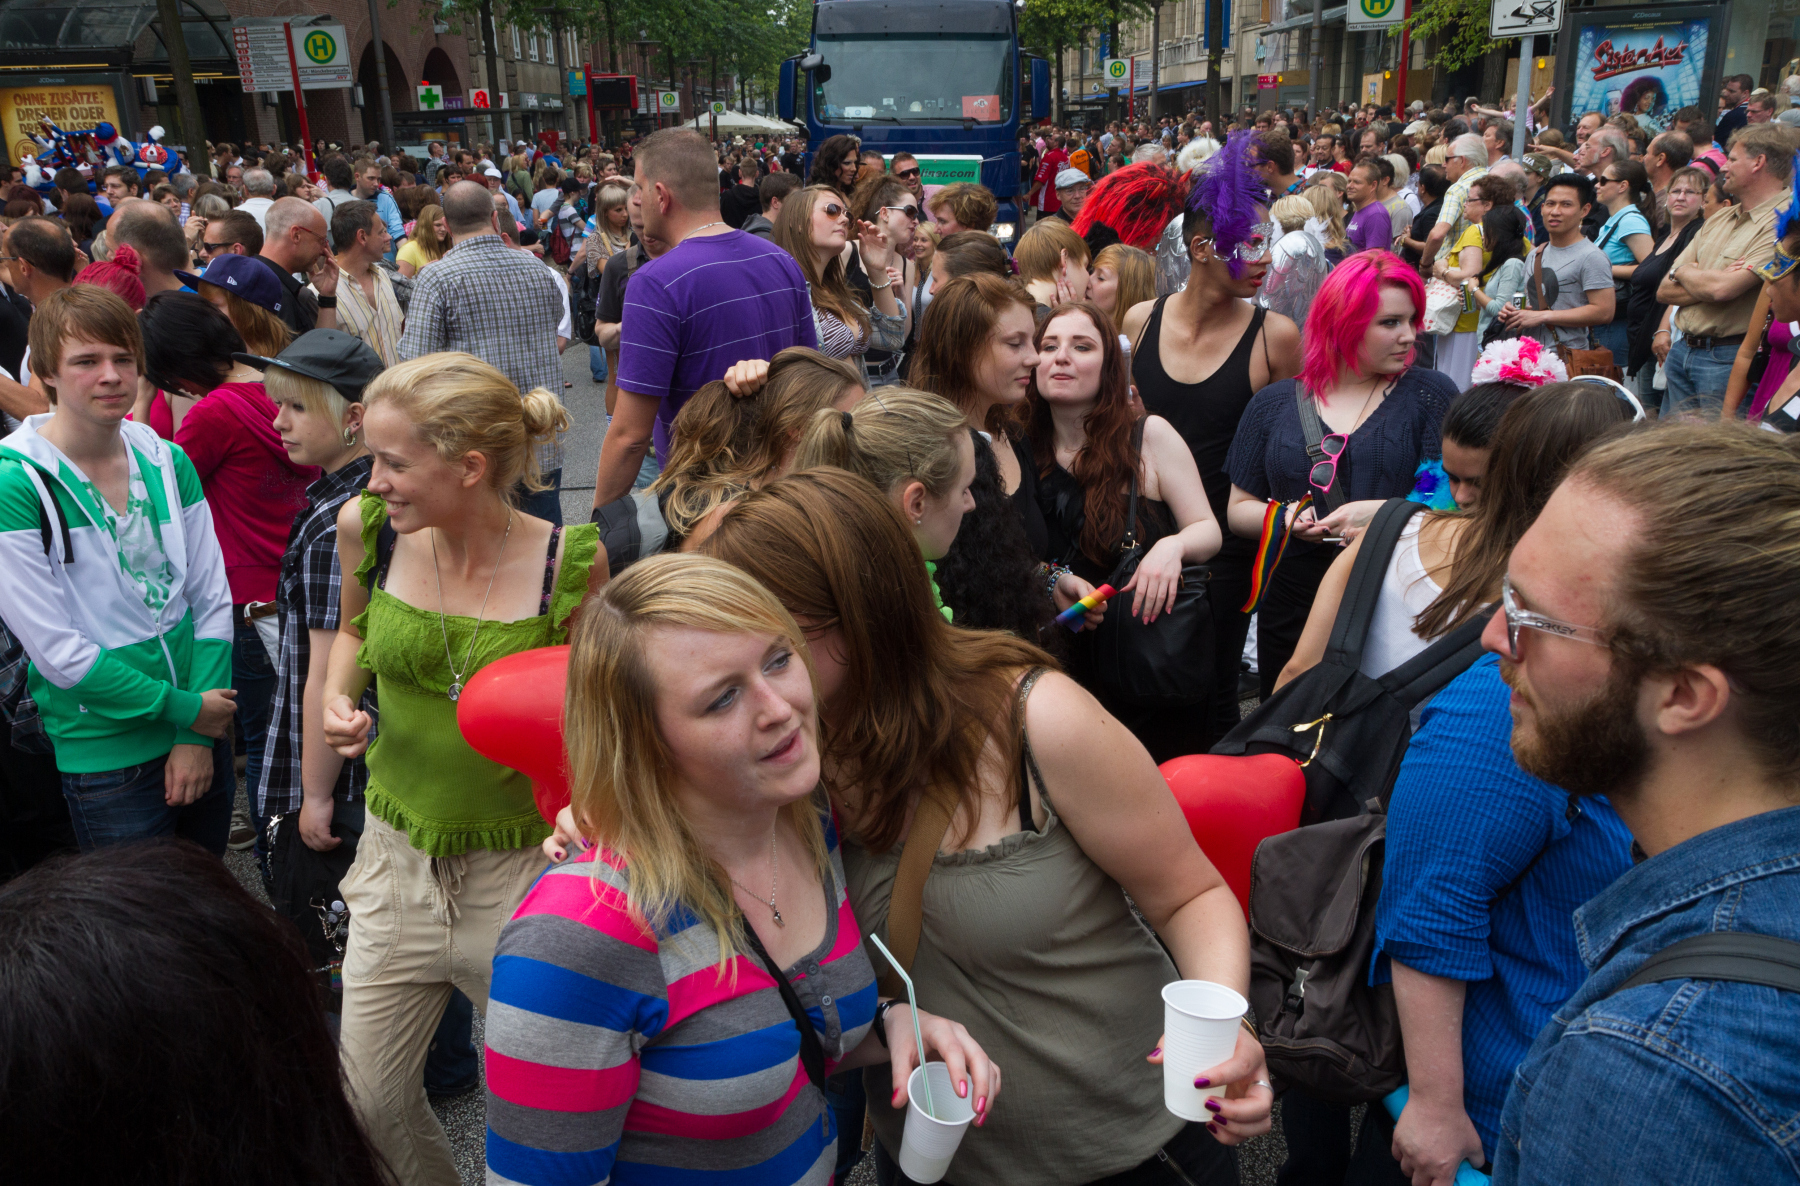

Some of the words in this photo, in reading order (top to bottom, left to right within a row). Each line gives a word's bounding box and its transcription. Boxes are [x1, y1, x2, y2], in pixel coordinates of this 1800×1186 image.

[312, 38, 329, 56] H
[1591, 39, 1648, 73] Sister
[1645, 34, 1689, 70] Act
[13, 93, 47, 106] OHNE
[16, 107, 68, 121] DREHEN
[70, 106, 106, 120] ODER
[63, 121, 97, 133] LASSE
[920, 168, 975, 178] liner.com
[1535, 620, 1577, 635] OAKLEY
